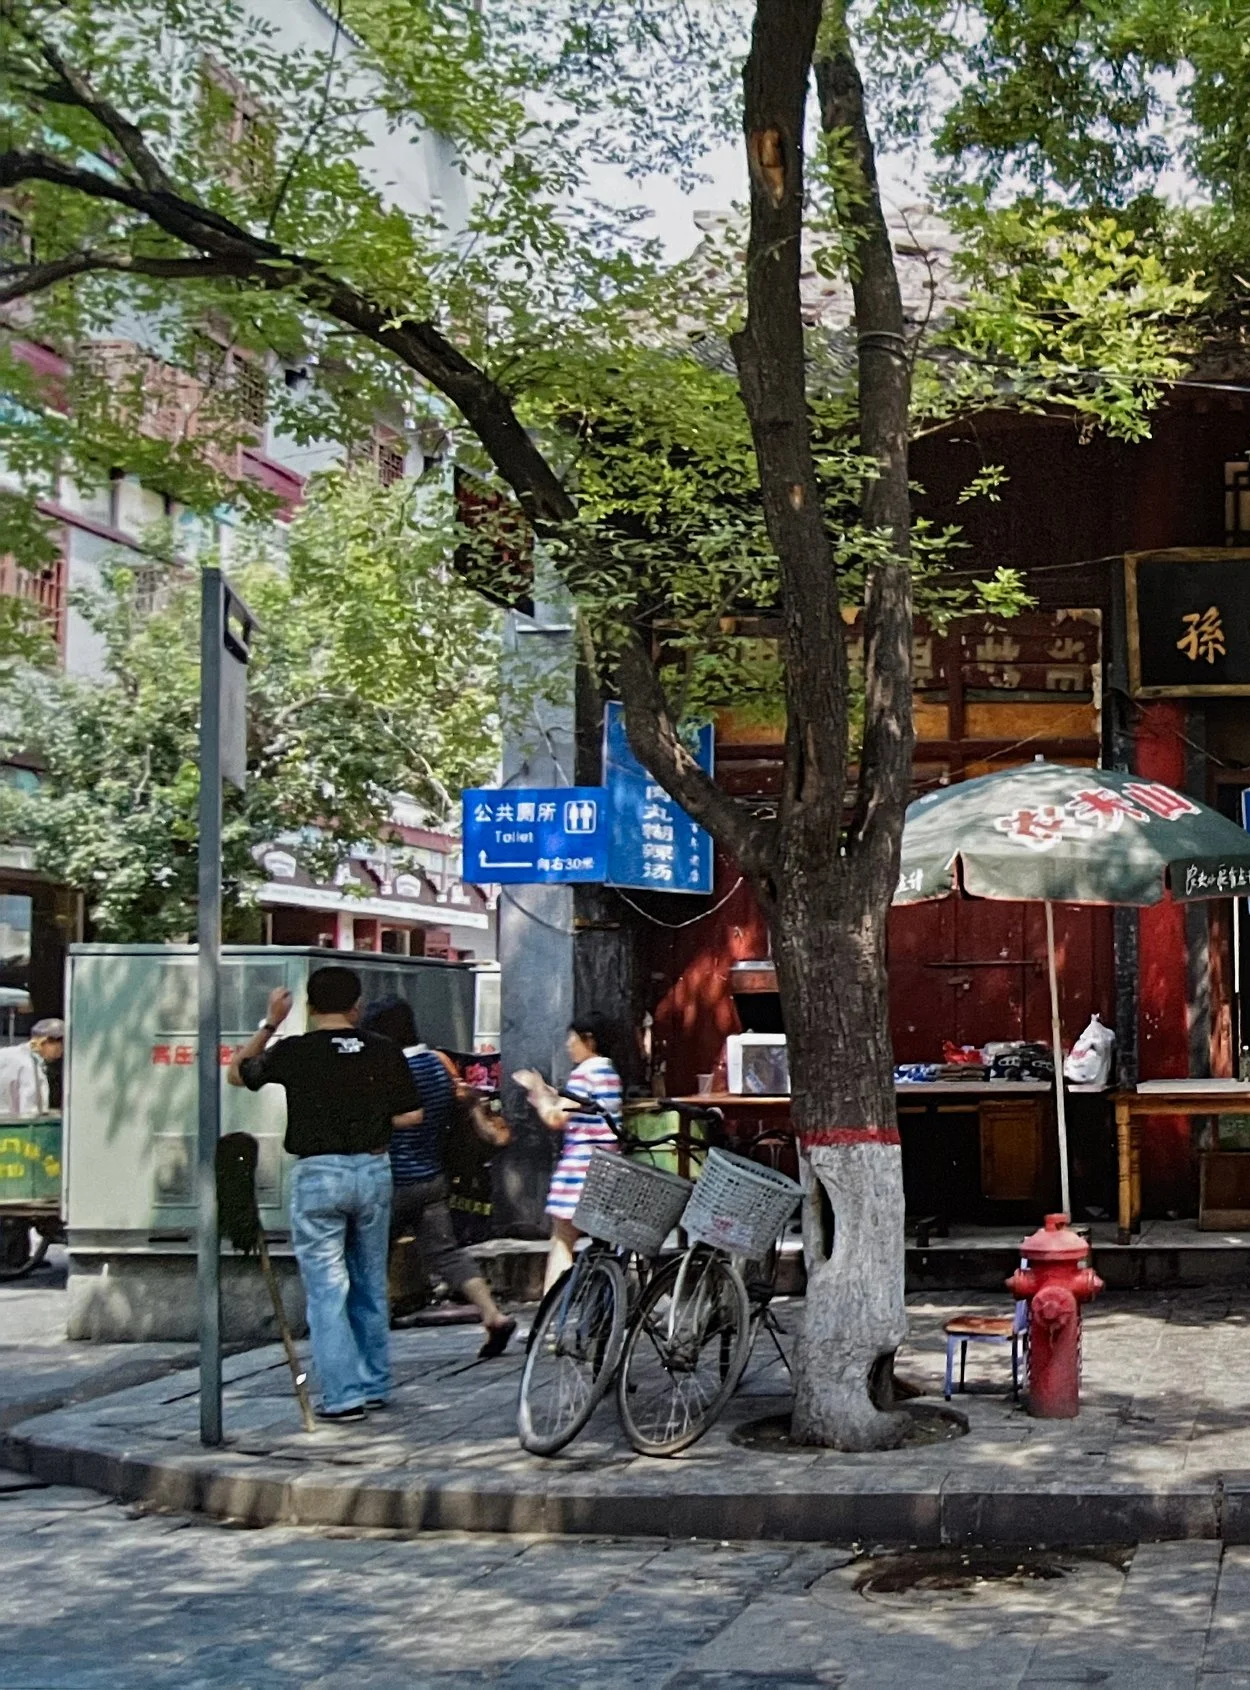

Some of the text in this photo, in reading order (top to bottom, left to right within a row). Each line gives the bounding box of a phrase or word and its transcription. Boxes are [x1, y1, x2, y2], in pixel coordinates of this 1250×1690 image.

[495, 830, 534, 844] Toilet
[642, 770, 675, 881] 肉丸糊辣汤
